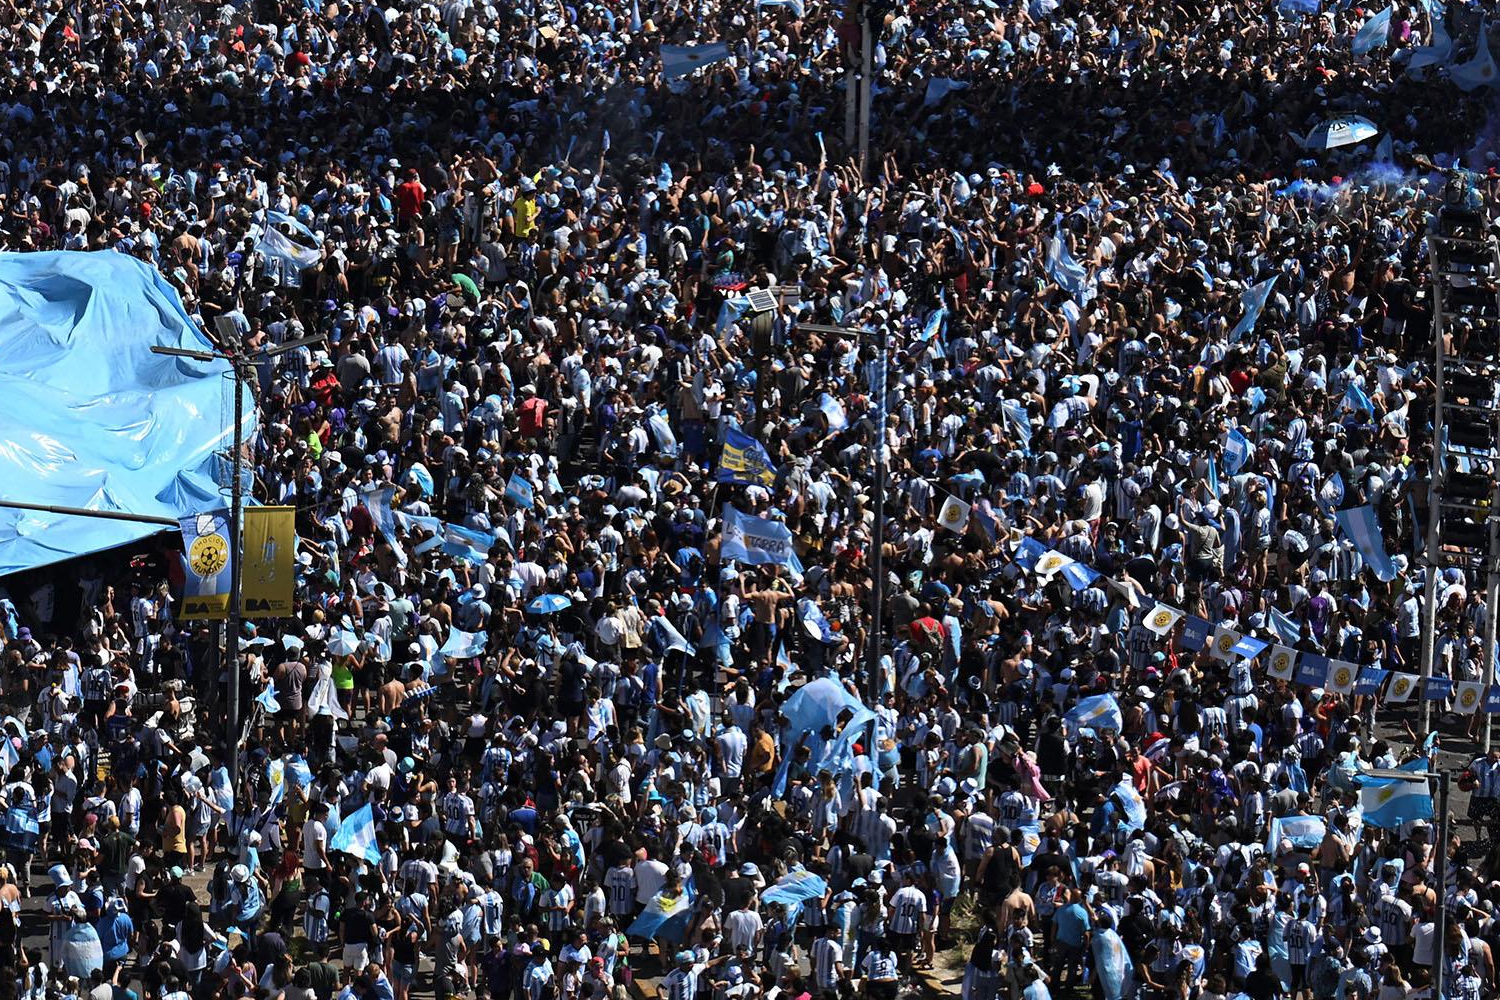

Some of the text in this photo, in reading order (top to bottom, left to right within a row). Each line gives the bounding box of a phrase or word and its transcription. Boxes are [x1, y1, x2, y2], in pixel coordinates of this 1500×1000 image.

[193, 556, 228, 576] MUNDIAL
[184, 602, 210, 615] BA
[245, 598, 270, 611] BA
[448, 805, 460, 820] 10
[612, 886, 625, 901] 10
[901, 903, 914, 917] 10
[1384, 911, 1396, 924] 10
